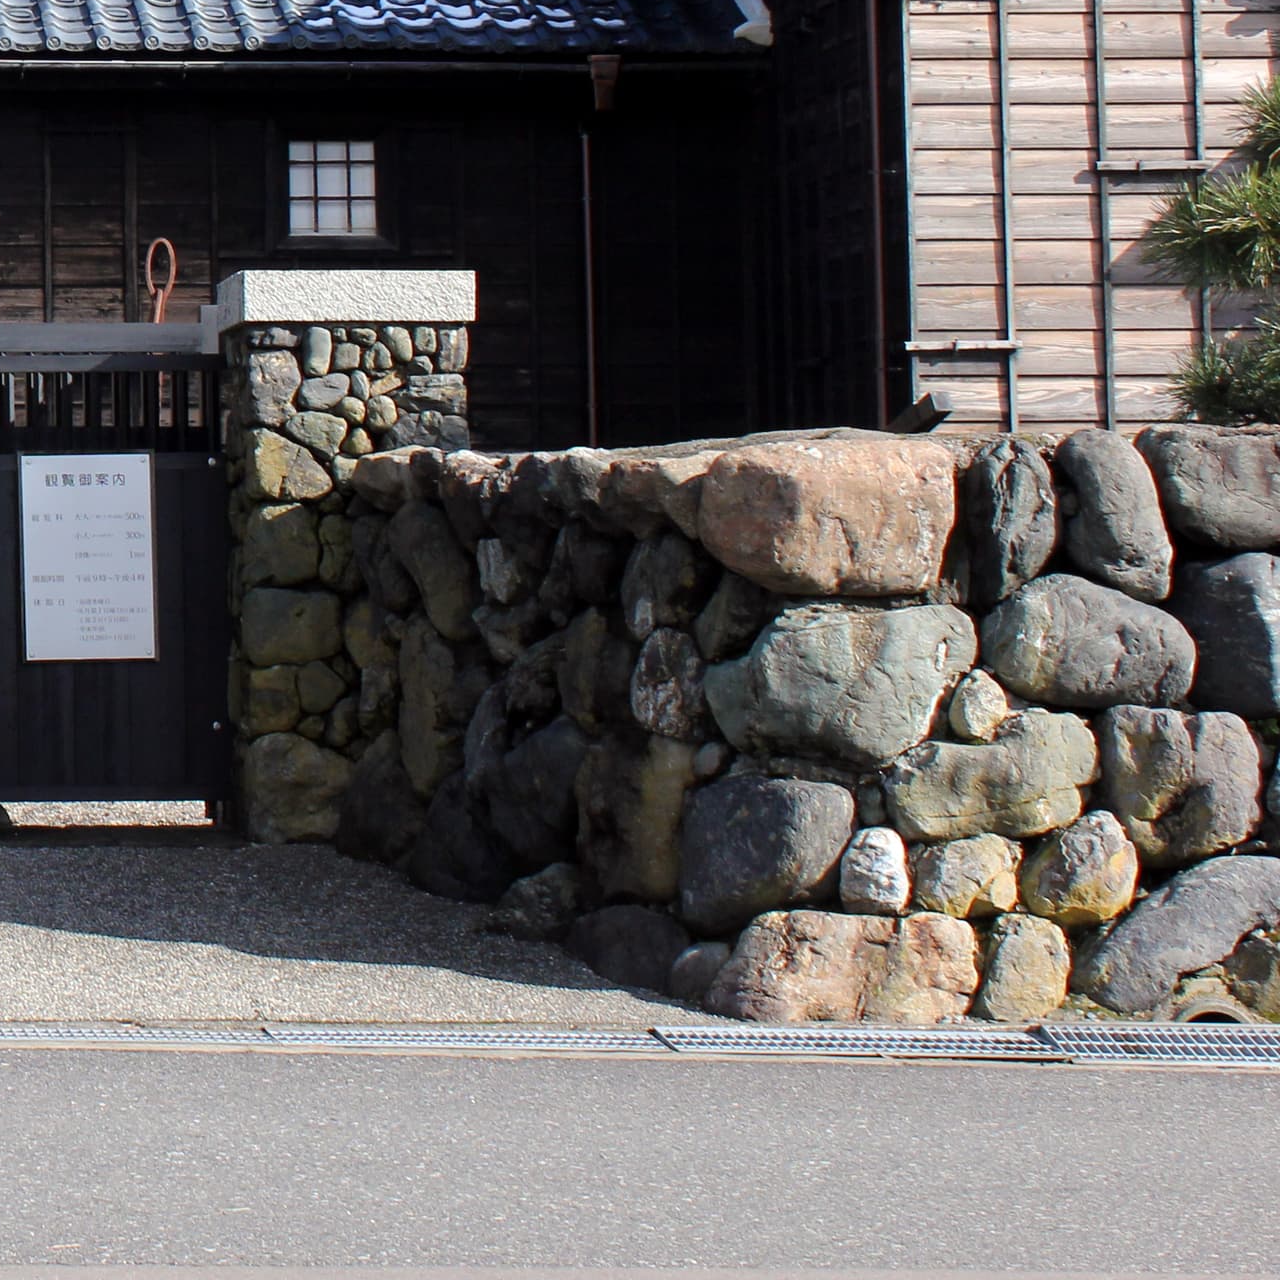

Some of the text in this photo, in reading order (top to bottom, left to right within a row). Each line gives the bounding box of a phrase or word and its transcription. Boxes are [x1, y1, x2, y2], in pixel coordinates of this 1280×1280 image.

[45, 473, 126, 487] 観覧御案内
